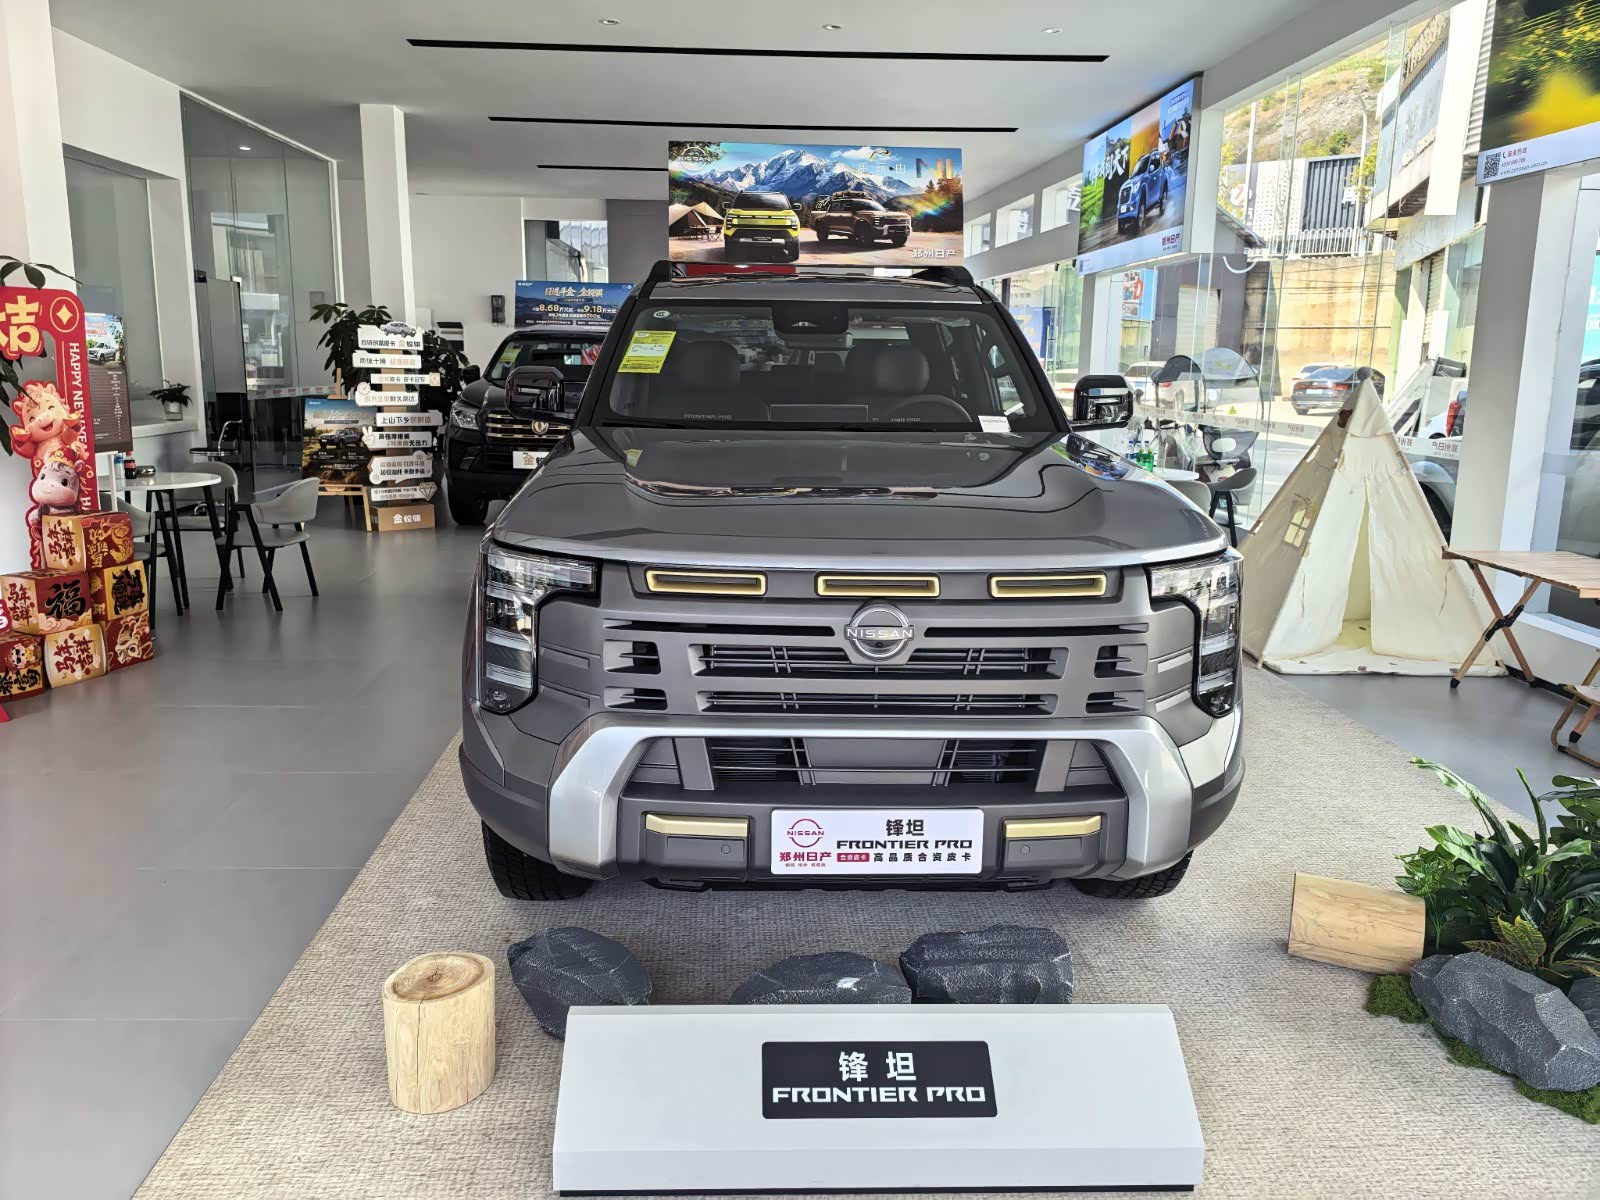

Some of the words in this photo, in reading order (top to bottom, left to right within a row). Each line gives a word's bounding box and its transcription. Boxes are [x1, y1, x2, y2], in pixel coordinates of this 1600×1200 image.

[912, 248, 957, 259] 郑州日产
[69, 342, 83, 388] HAPPY
[45, 579, 87, 619] 福
[847, 629, 913, 638] NISSAN
[885, 819, 925, 837] 锋坦
[836, 840, 929, 849] FRONTIER
[934, 839, 973, 849] PRO
[779, 851, 832, 862] 郑州日产
[873, 852, 972, 862] 高品质合资皮卡
[838, 1051, 917, 1082] 锋坦
[772, 1087, 919, 1103] FRONTIER
[926, 1086, 986, 1102] PRO
